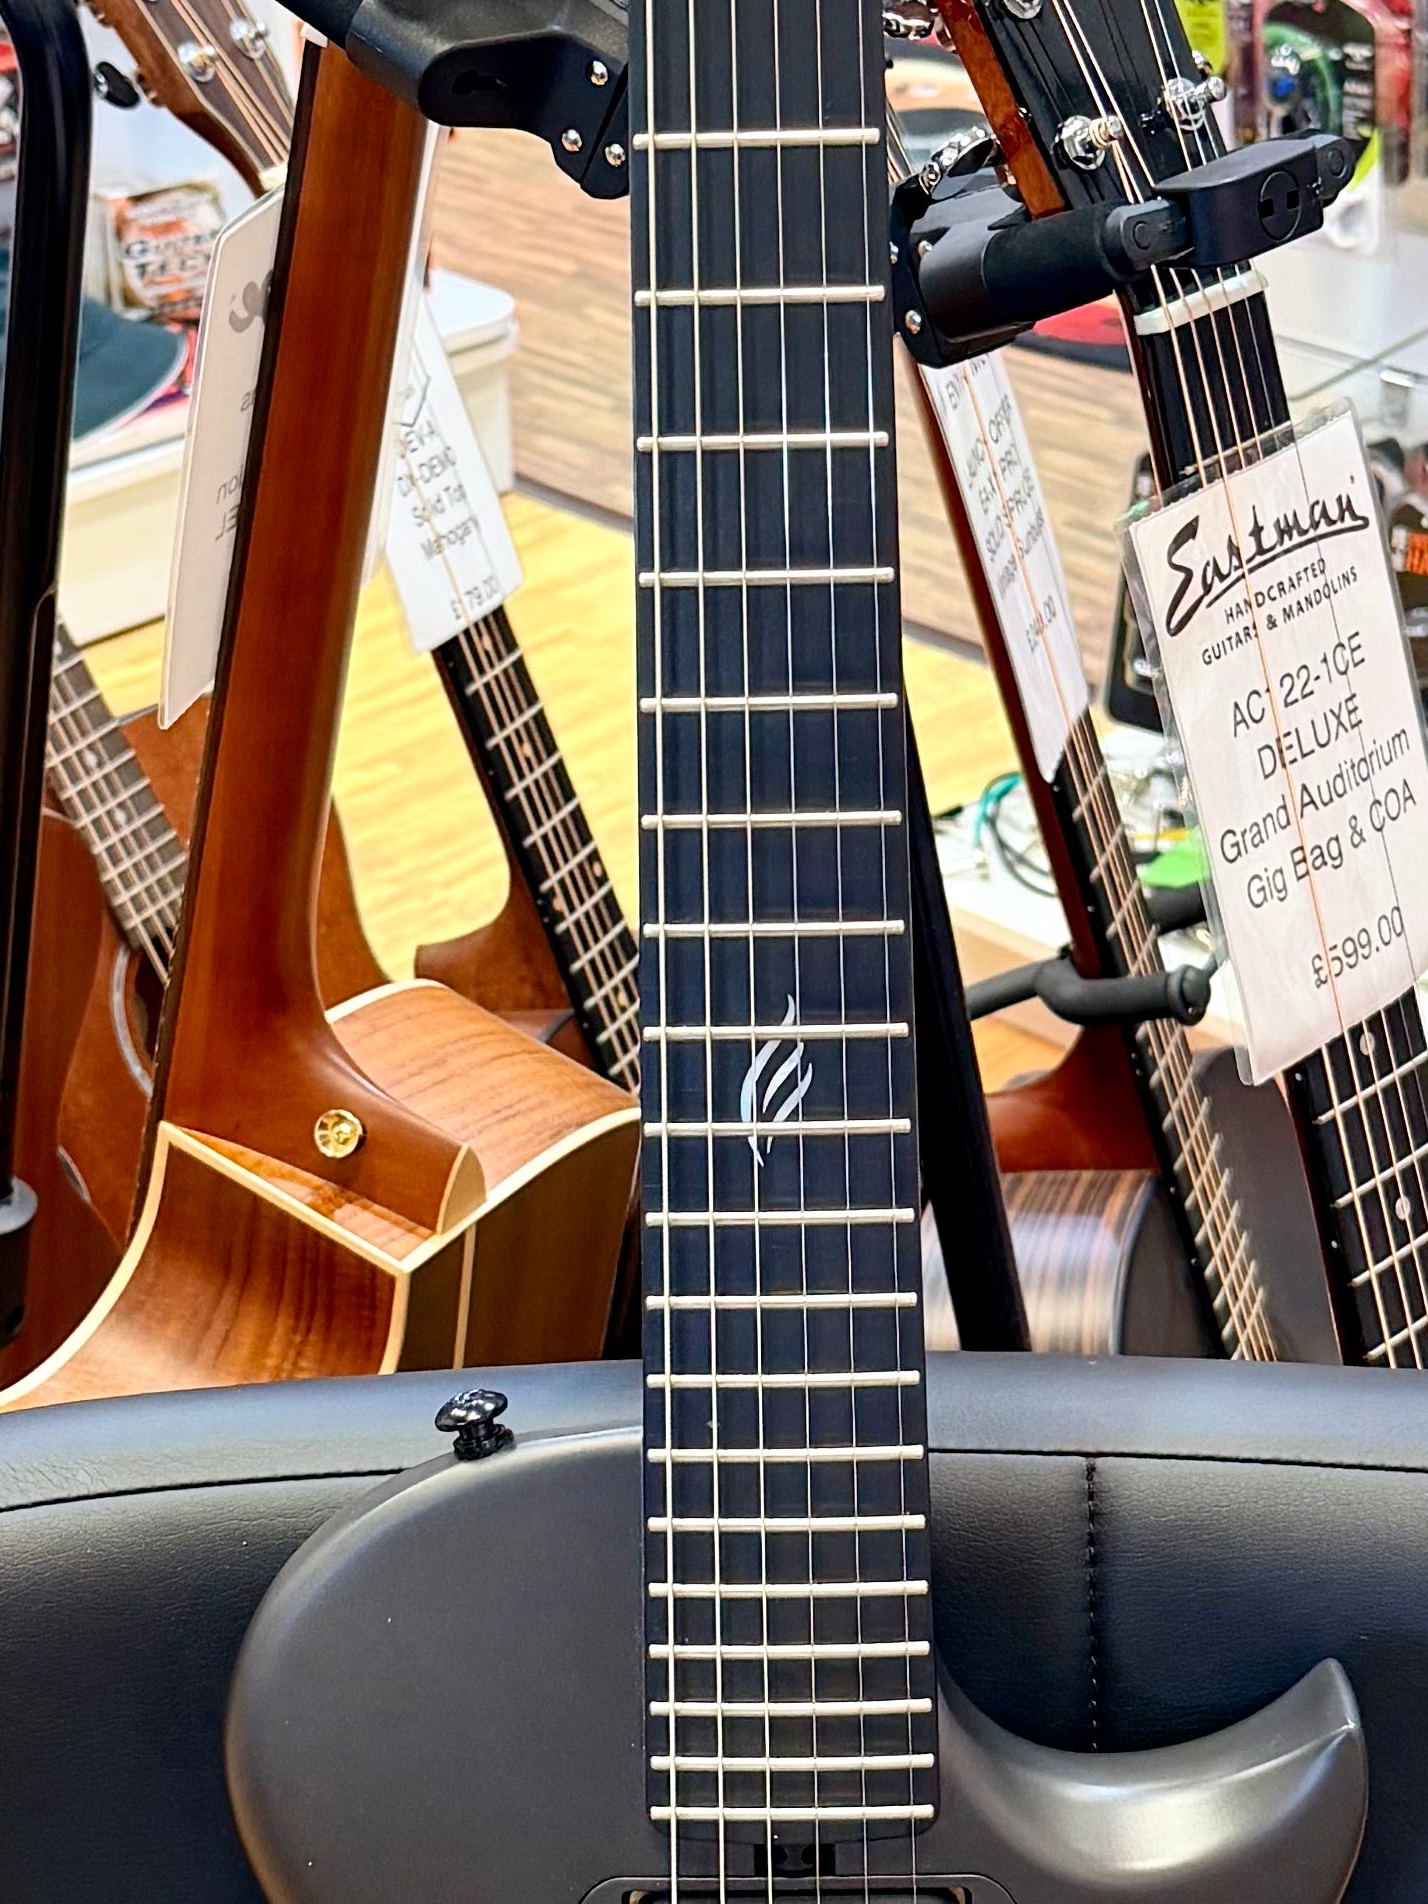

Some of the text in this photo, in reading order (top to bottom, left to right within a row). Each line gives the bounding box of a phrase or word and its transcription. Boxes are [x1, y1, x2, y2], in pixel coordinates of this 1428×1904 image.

[451, 574, 501, 621] £79.00
[1165, 493, 1370, 637] Eastman
[1223, 558, 1327, 625] HANDCRAFTED
[1201, 565, 1359, 666] GUITARS & MANDOLINS
[1257, 692, 1364, 781] DELUXE
[1219, 728, 1411, 865] Grand Auditorium
[1246, 778, 1418, 909] Gig Bag & COA
[1311, 905, 1405, 990] £599.00
